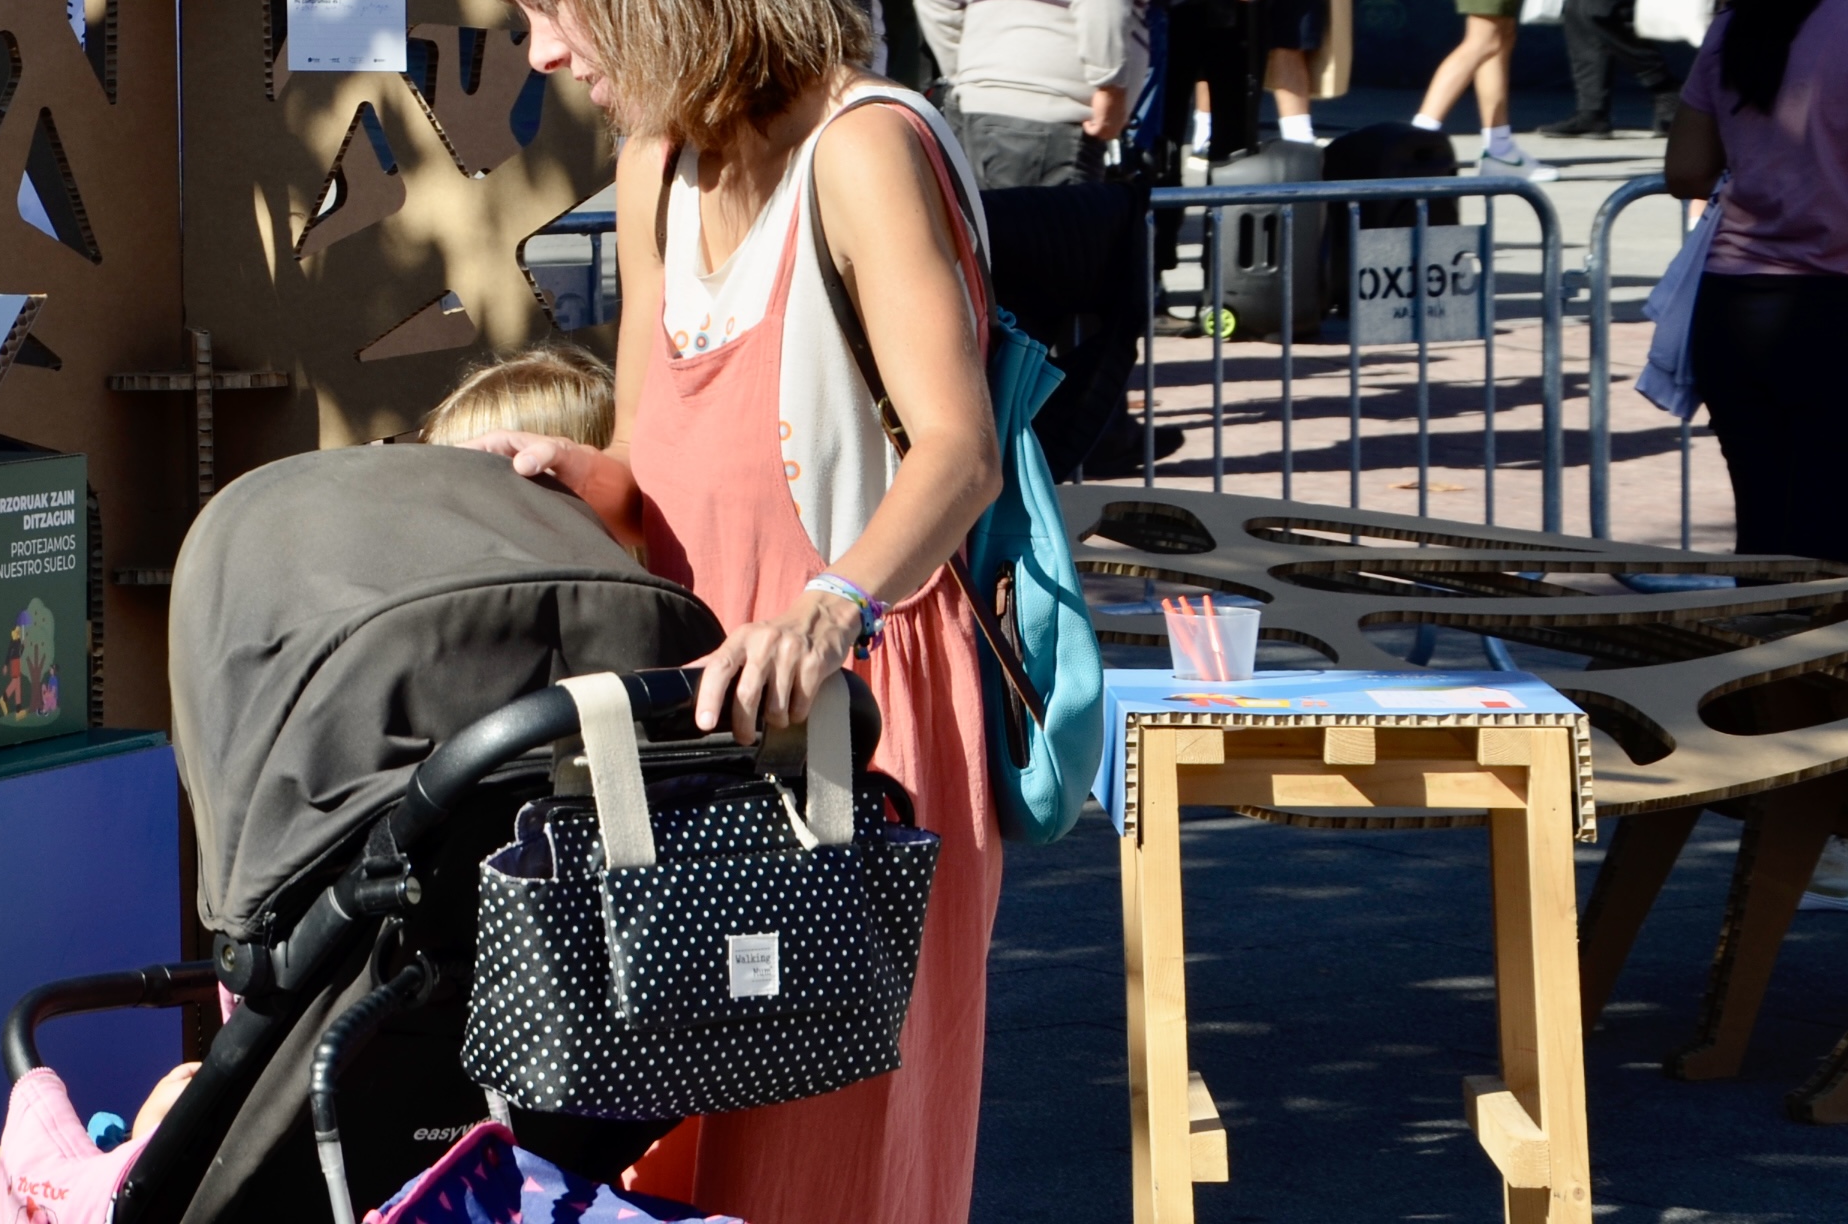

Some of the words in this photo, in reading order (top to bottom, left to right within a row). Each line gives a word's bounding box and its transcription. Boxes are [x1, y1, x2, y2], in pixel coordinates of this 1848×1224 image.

[49, 489, 75, 507] ZAIN
[23, 509, 75, 531] DITZAGUN
[10, 534, 76, 558] PROTEJAMOS
[43, 554, 76, 576] SUELO
[735, 953, 771, 965] Walking
